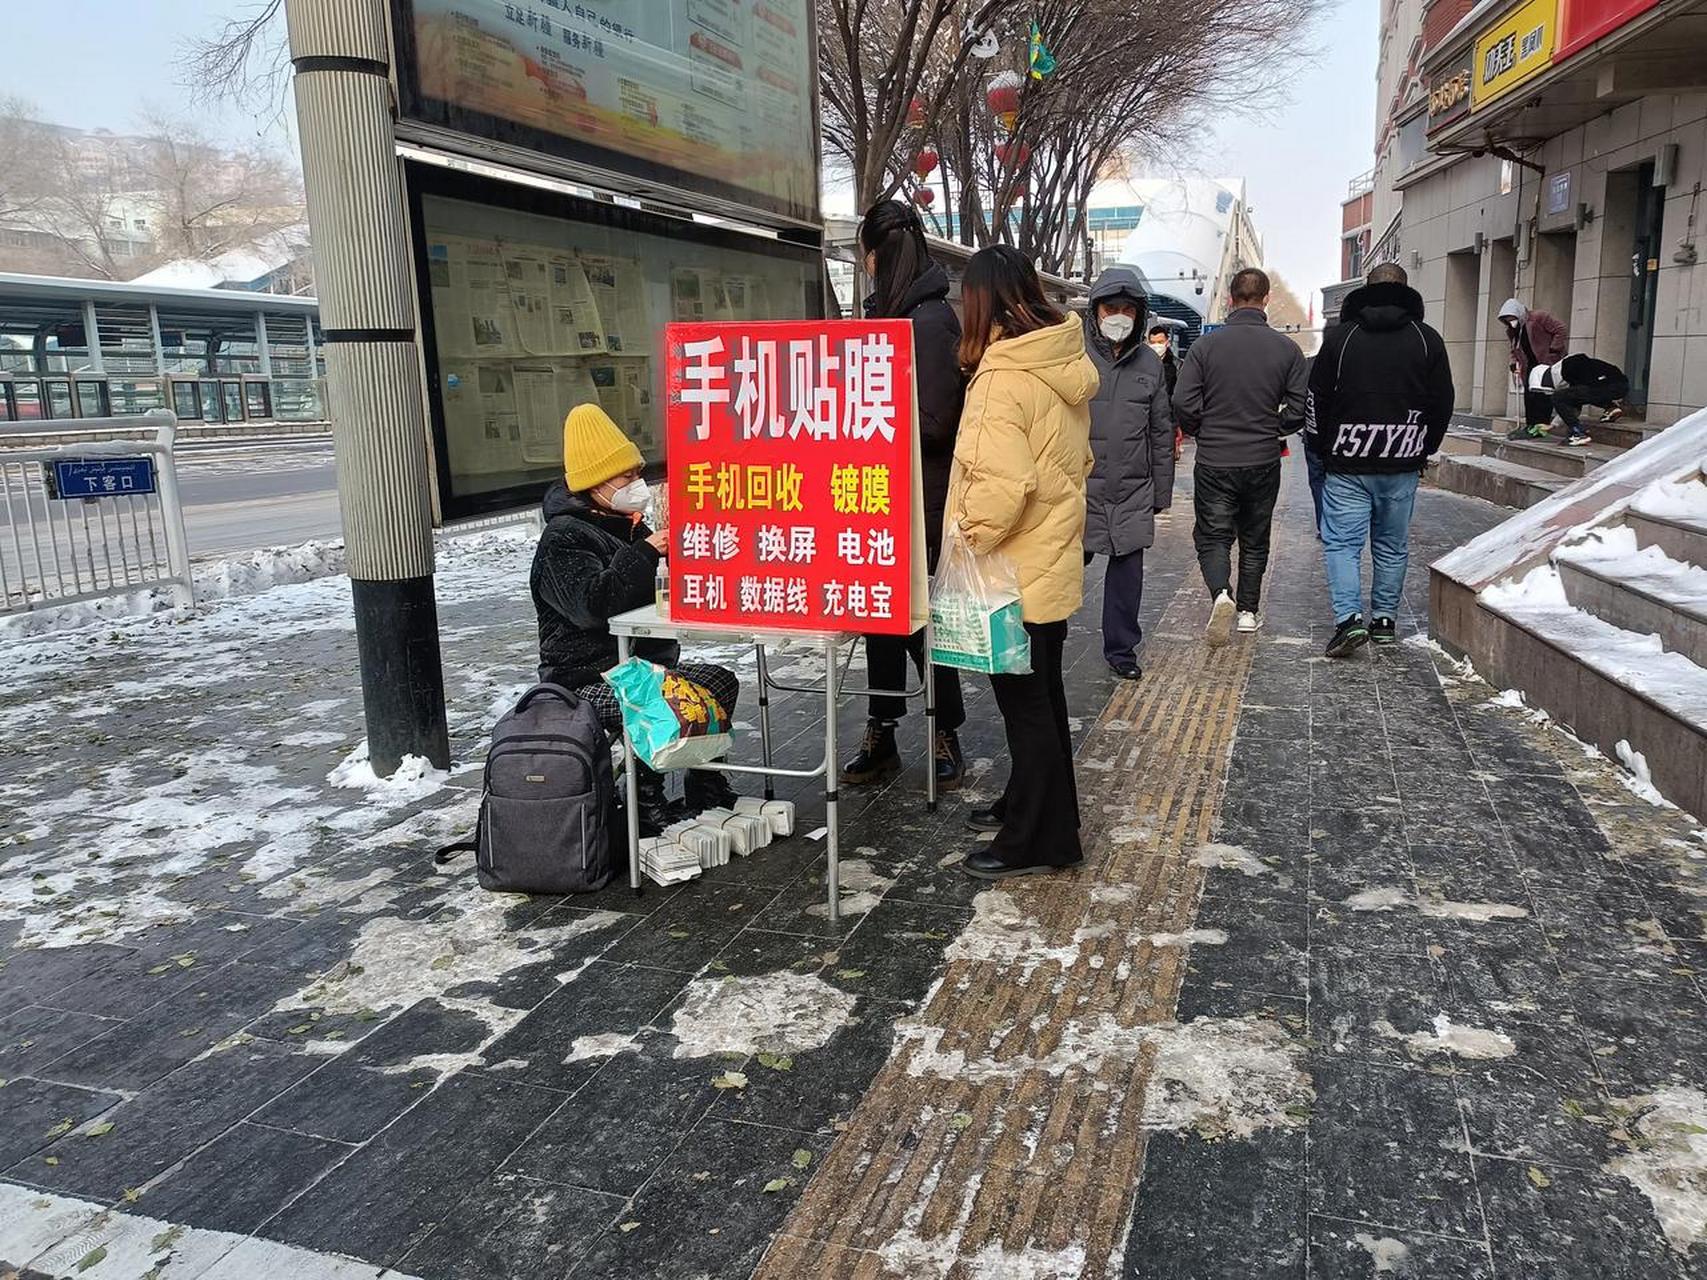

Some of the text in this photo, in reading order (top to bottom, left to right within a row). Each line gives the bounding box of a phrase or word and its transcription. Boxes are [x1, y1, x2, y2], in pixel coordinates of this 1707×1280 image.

[681, 334, 896, 443] 手机贴膜
[83, 475, 134, 492] 下客口
[687, 462, 891, 515] 手机回收 镀膜
[683, 522, 896, 566] 维修 换屏 电池
[683, 573, 892, 618] 耳机 数据线 充电宝
